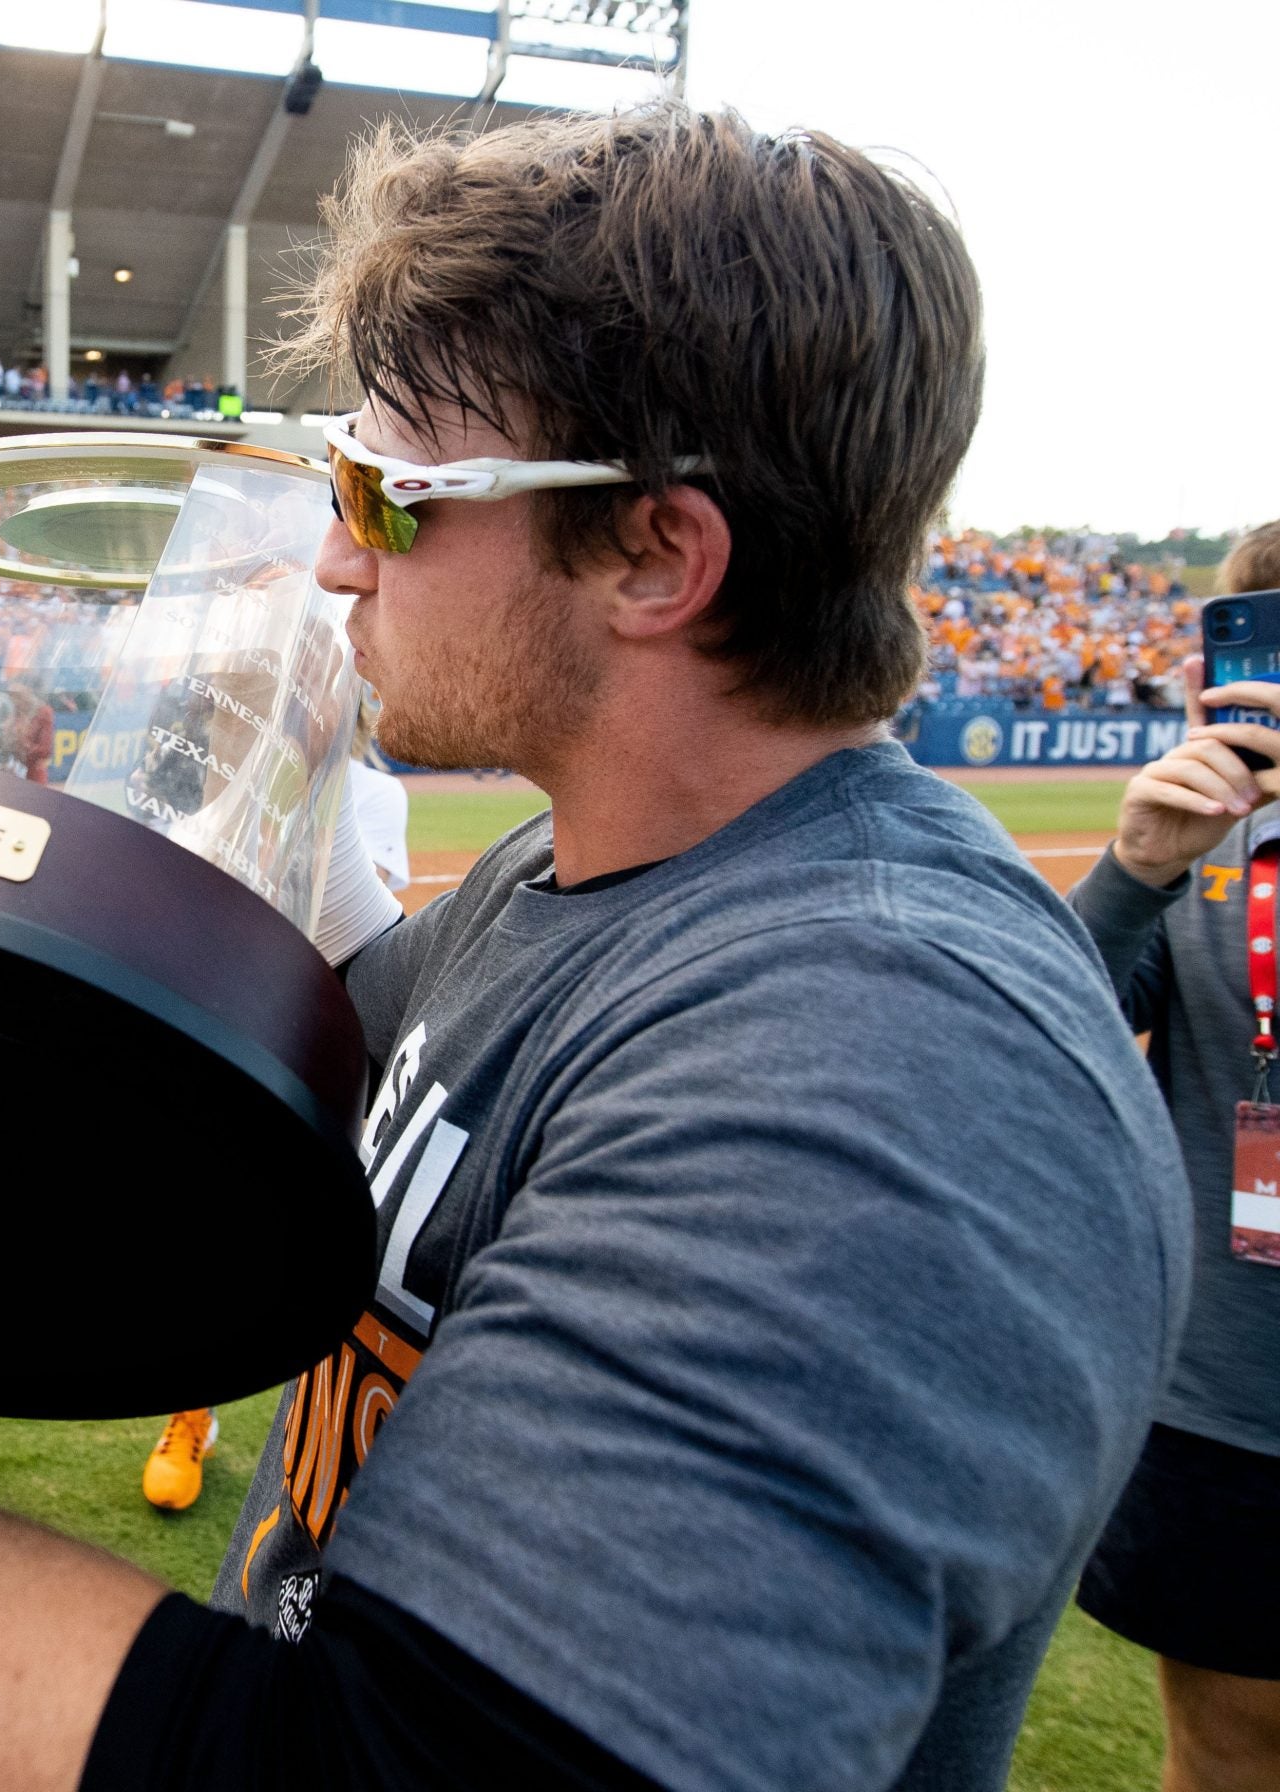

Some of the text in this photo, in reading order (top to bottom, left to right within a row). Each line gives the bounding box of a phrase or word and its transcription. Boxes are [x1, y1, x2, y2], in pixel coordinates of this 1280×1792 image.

[151, 726, 237, 781] TEXAS
[1011, 721, 1050, 760] IT
[1047, 721, 1142, 760] JUST
[126, 787, 277, 899] VANRBILT
[1202, 864, 1243, 901] T
